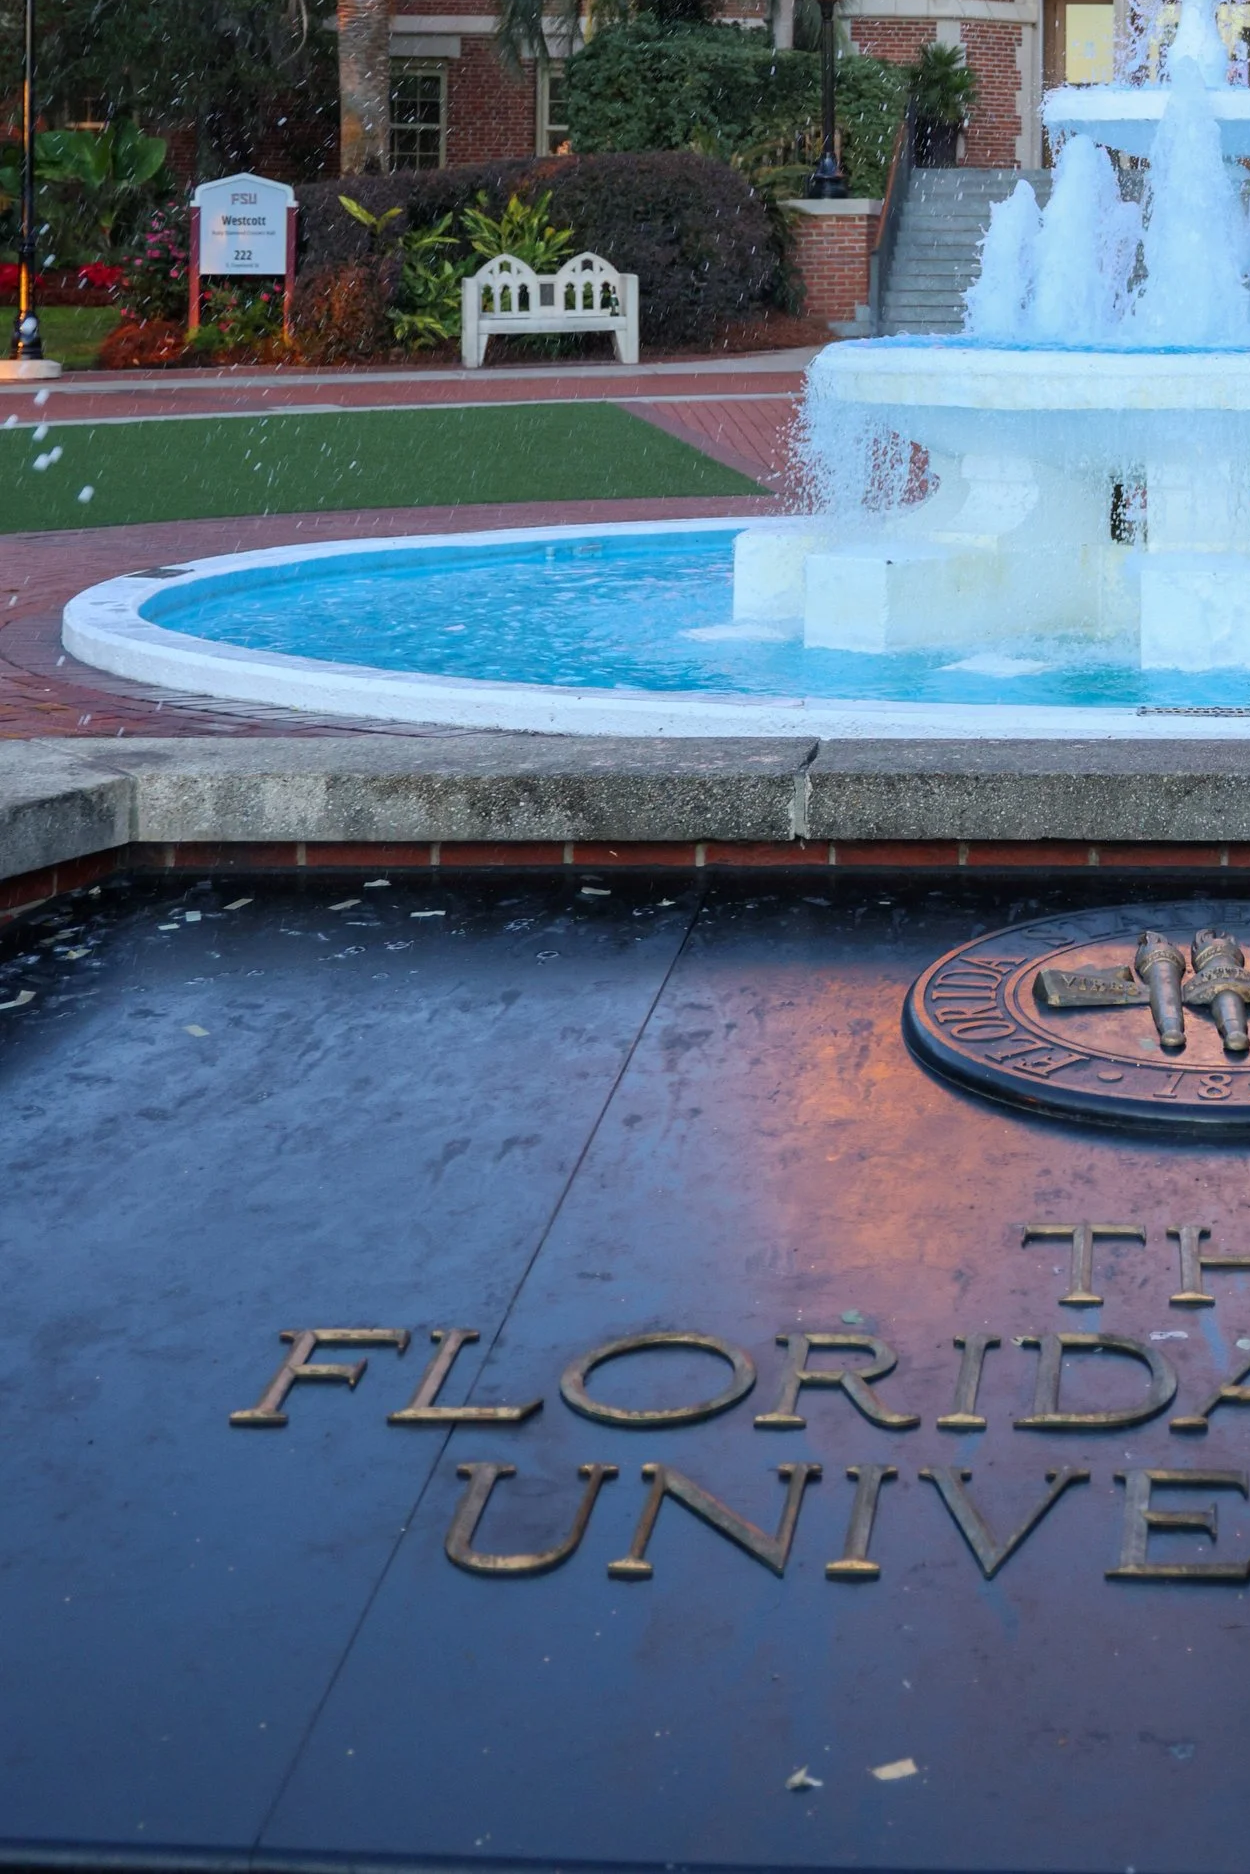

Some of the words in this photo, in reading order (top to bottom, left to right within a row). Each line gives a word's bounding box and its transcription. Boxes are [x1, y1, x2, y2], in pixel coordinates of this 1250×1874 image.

[231, 193, 257, 205] FSU
[222, 215, 266, 226] Westcott
[234, 250, 252, 261] 222
[932, 957, 1090, 1079] FLORIDA
